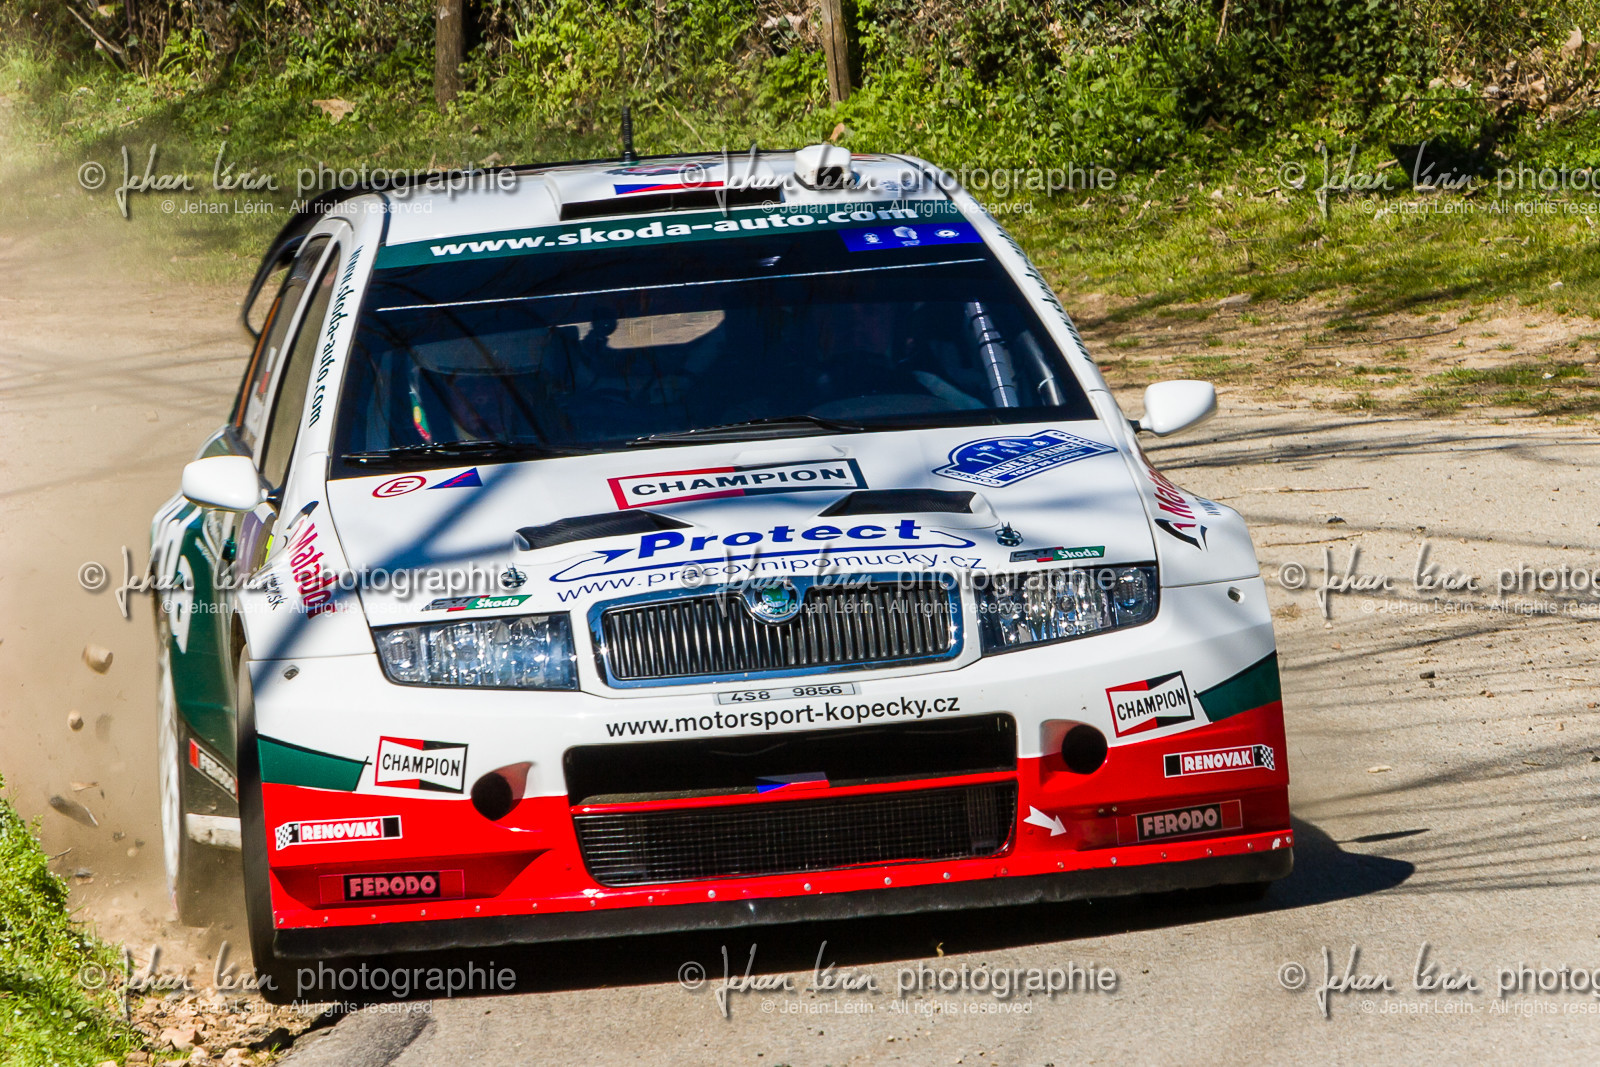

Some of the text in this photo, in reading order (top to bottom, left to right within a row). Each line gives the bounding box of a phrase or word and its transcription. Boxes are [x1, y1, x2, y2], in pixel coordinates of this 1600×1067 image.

[429, 207, 920, 257] www.skoda-auto.com
[308, 245, 364, 429] www.skoda-auto.com
[631, 468, 847, 497] CHAMPION
[638, 519, 921, 559] Protect
[557, 551, 987, 602] www.pracovnipomucky.cz
[731, 685, 842, 702] 4S8 9856
[1116, 687, 1186, 721] CHAMPION
[606, 696, 961, 737] www.motorsport-kopecky.cz
[382, 753, 461, 777] CHAMPION
[1183, 751, 1251, 772] RENOVAK
[301, 820, 380, 841] RENOVAK
[1142, 807, 1218, 837] FERODO
[348, 875, 437, 898] FERODO
